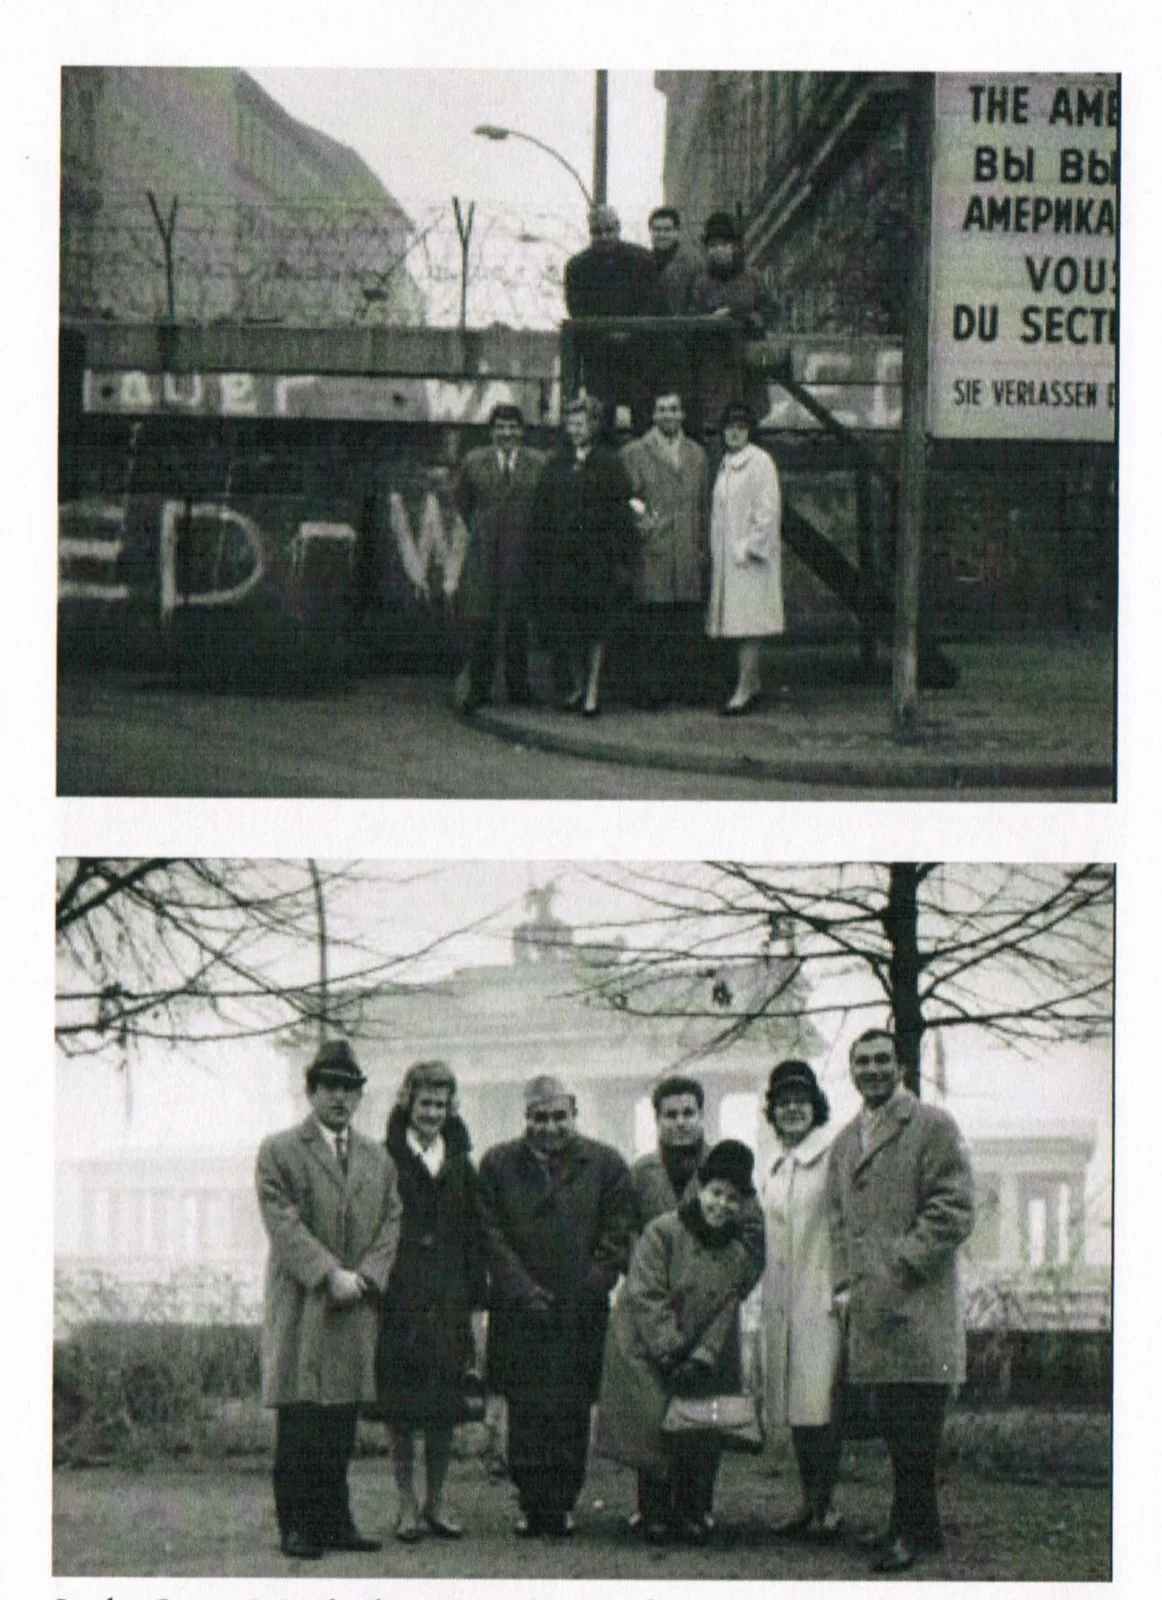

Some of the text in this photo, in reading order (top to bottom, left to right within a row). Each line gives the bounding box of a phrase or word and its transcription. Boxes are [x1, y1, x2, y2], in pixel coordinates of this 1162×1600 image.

[969, 85, 1029, 124] THE
[974, 145, 1034, 182] ВЫ
[1025, 256, 1117, 294] VOU
[953, 304, 998, 341] DU
[953, 379, 982, 406] SIE
[992, 379, 1097, 409] VERLASSEN
